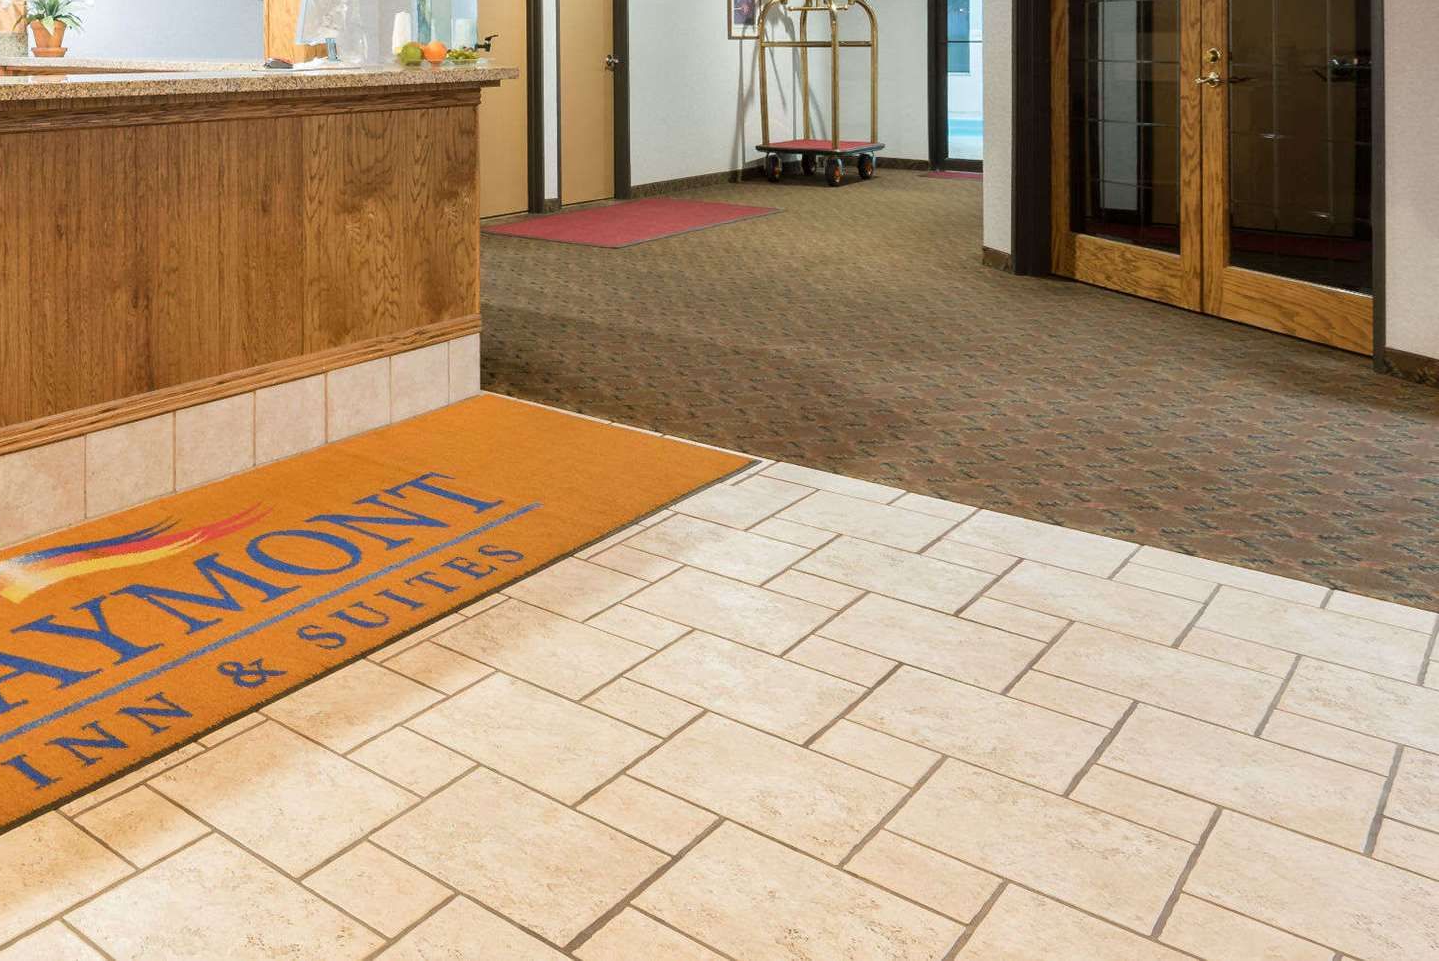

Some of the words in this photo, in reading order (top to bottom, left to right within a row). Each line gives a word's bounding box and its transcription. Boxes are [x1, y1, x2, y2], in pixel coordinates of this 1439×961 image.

[0, 693, 195, 790] INN
[217, 658, 288, 689] &
[297, 543, 526, 651] SUITES
